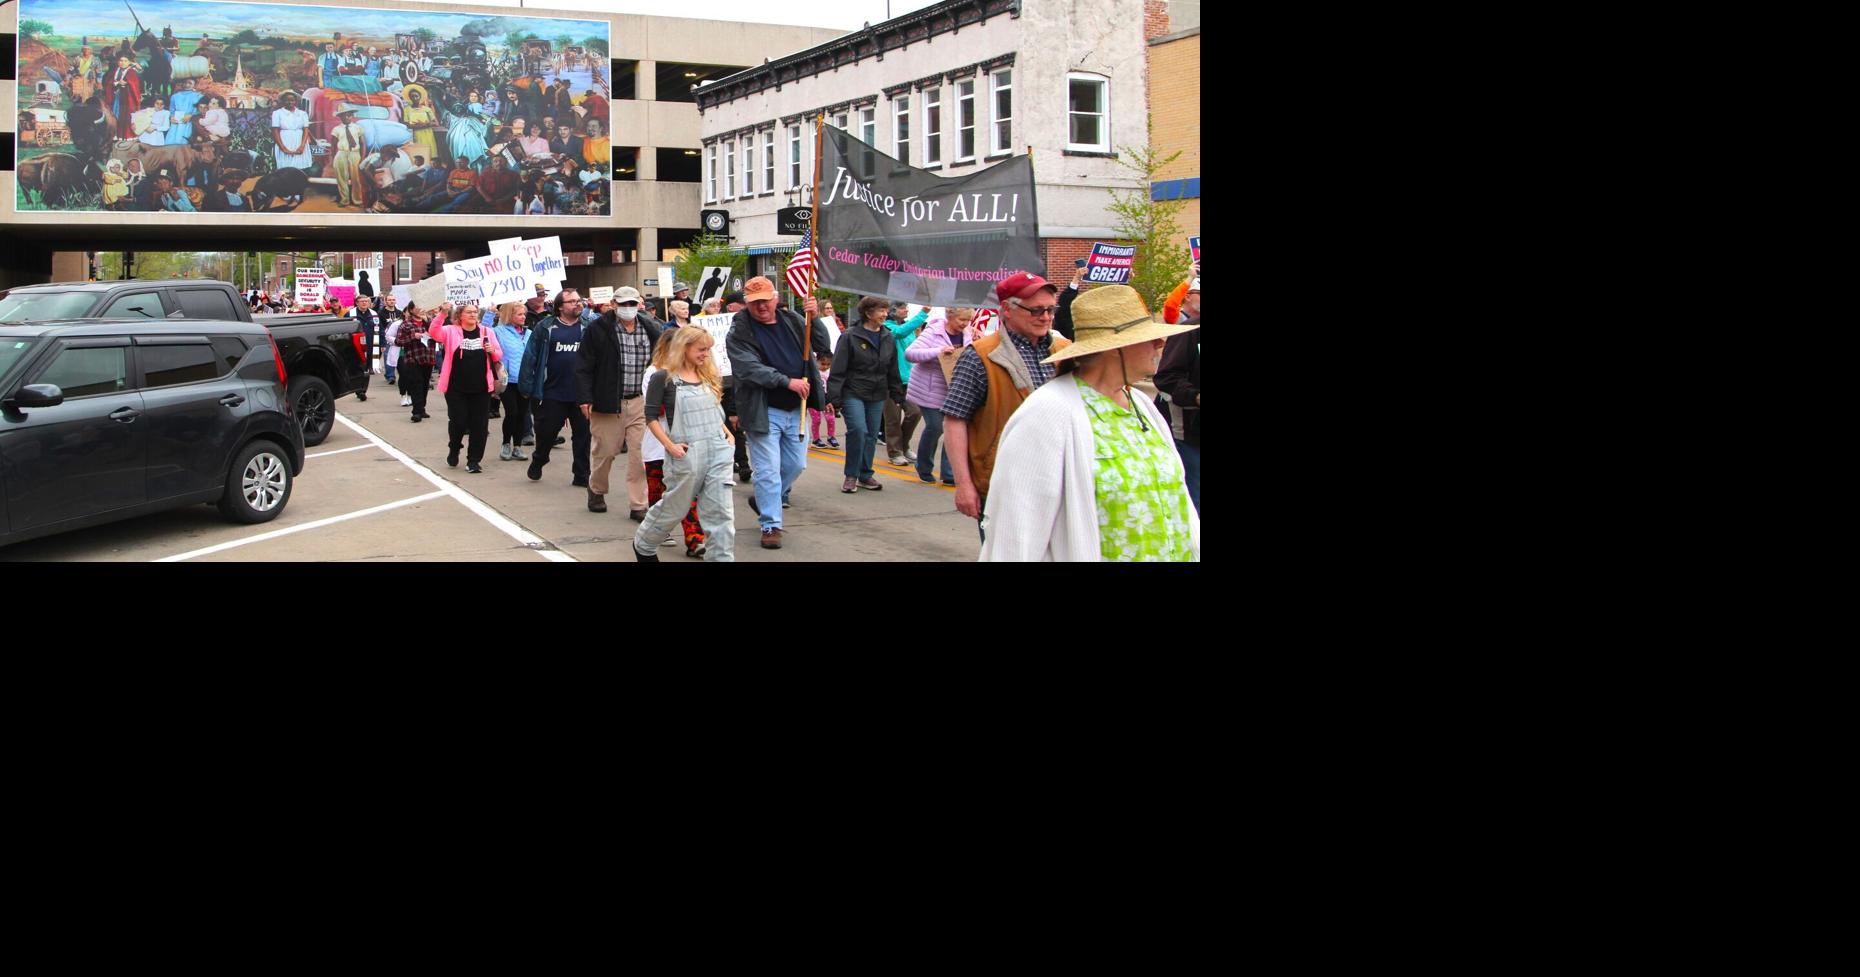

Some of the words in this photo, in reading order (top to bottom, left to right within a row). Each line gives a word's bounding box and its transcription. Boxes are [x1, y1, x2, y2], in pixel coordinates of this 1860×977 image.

[822, 166, 895, 216] Justice
[902, 195, 940, 227] for
[948, 193, 1018, 222] ALL!
[454, 264, 484, 282] Say
[484, 257, 503, 275] NO
[506, 255, 521, 271] to
[530, 256, 562, 277] together
[828, 246, 860, 265] Cedar
[863, 252, 901, 276] Valley
[1090, 266, 1129, 281] GREAT
